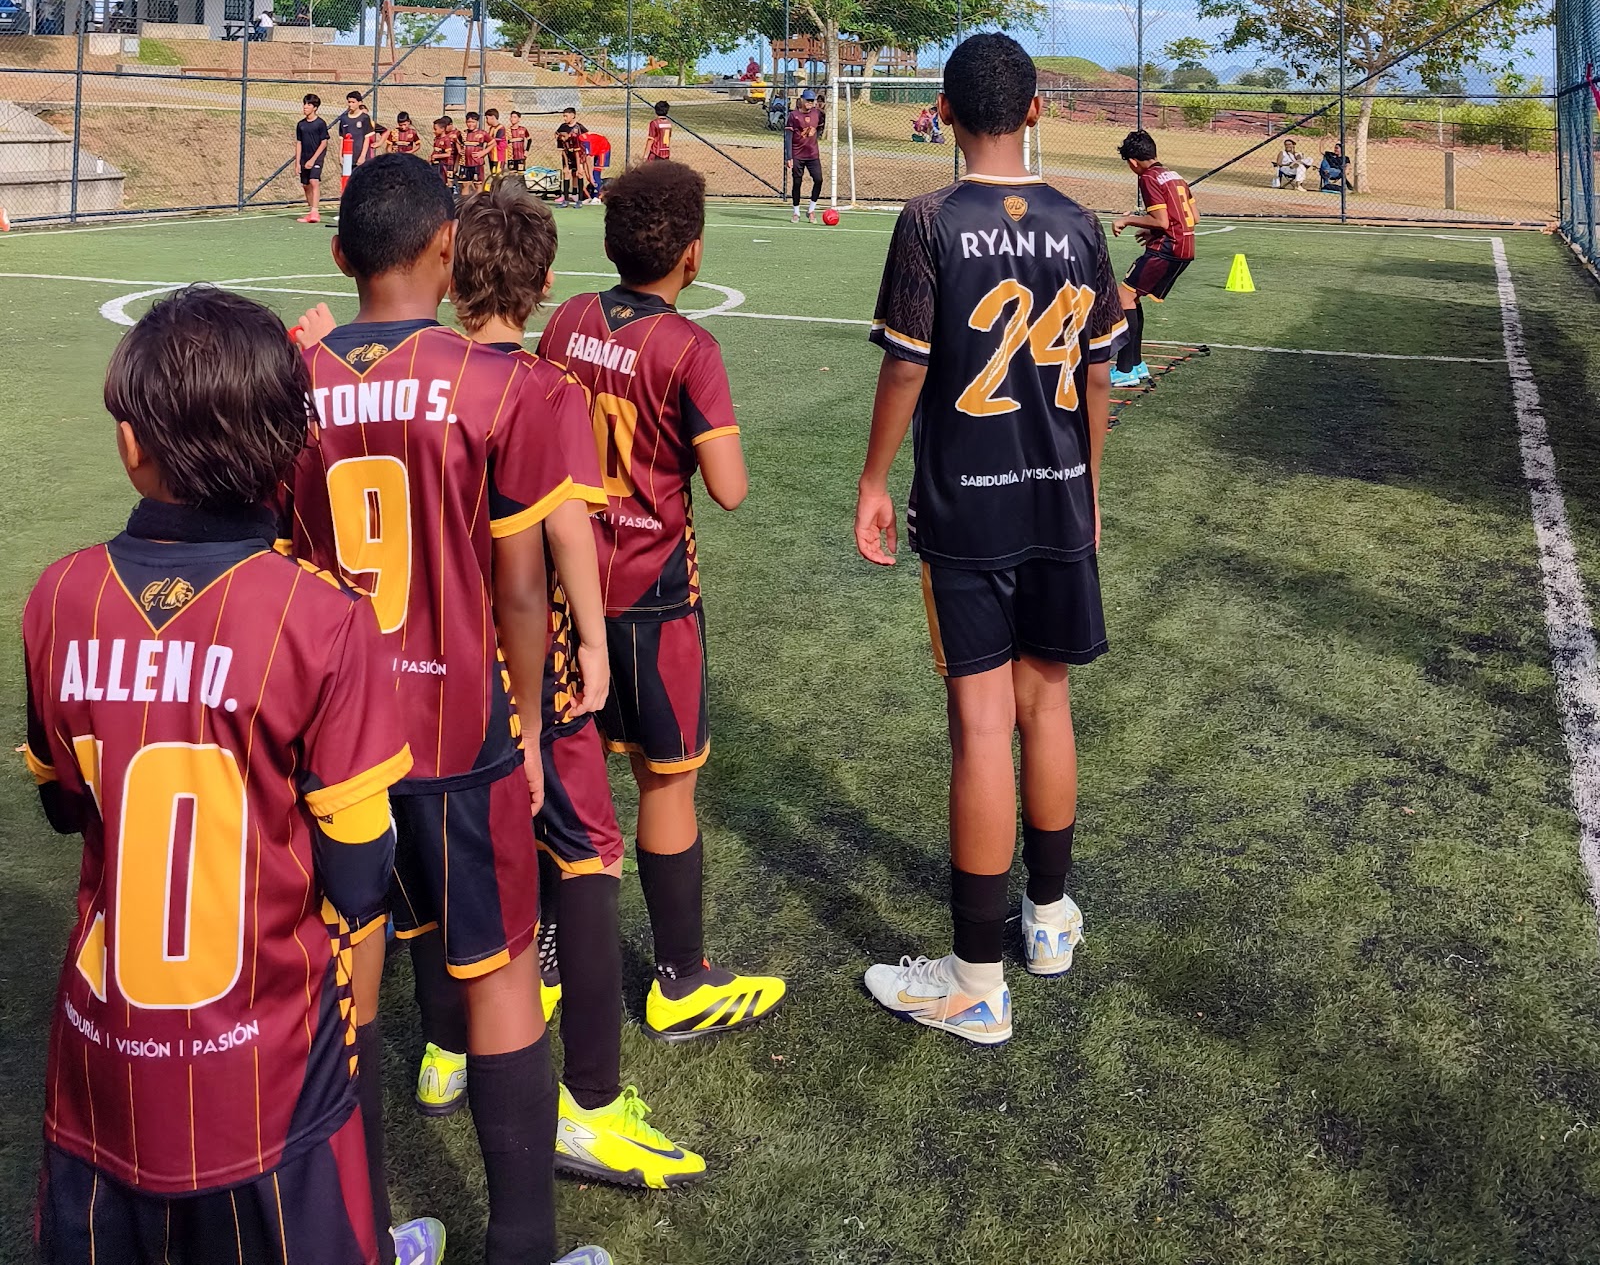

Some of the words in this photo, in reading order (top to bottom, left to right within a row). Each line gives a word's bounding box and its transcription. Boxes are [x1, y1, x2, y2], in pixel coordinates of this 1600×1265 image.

[961, 228, 1036, 259] RYAN
[1045, 231, 1076, 262] M.
[565, 331, 625, 371] FABIÁN
[619, 347, 637, 377] D.
[954, 278, 1097, 418] 24
[425, 378, 457, 423] S.
[960, 469, 1020, 487] SABIDURÍA
[1025, 466, 1063, 481] VISIÓN
[1063, 461, 1086, 481] PASIÓN
[618, 515, 663, 530] PASIÓN
[326, 455, 413, 635] 9
[59, 638, 196, 703] ALLEN
[200, 644, 238, 713] O.
[401, 658, 447, 676] PASIÓN
[115, 1037, 171, 1058] VISIÓN
[192, 1019, 260, 1056] PASIÓN
